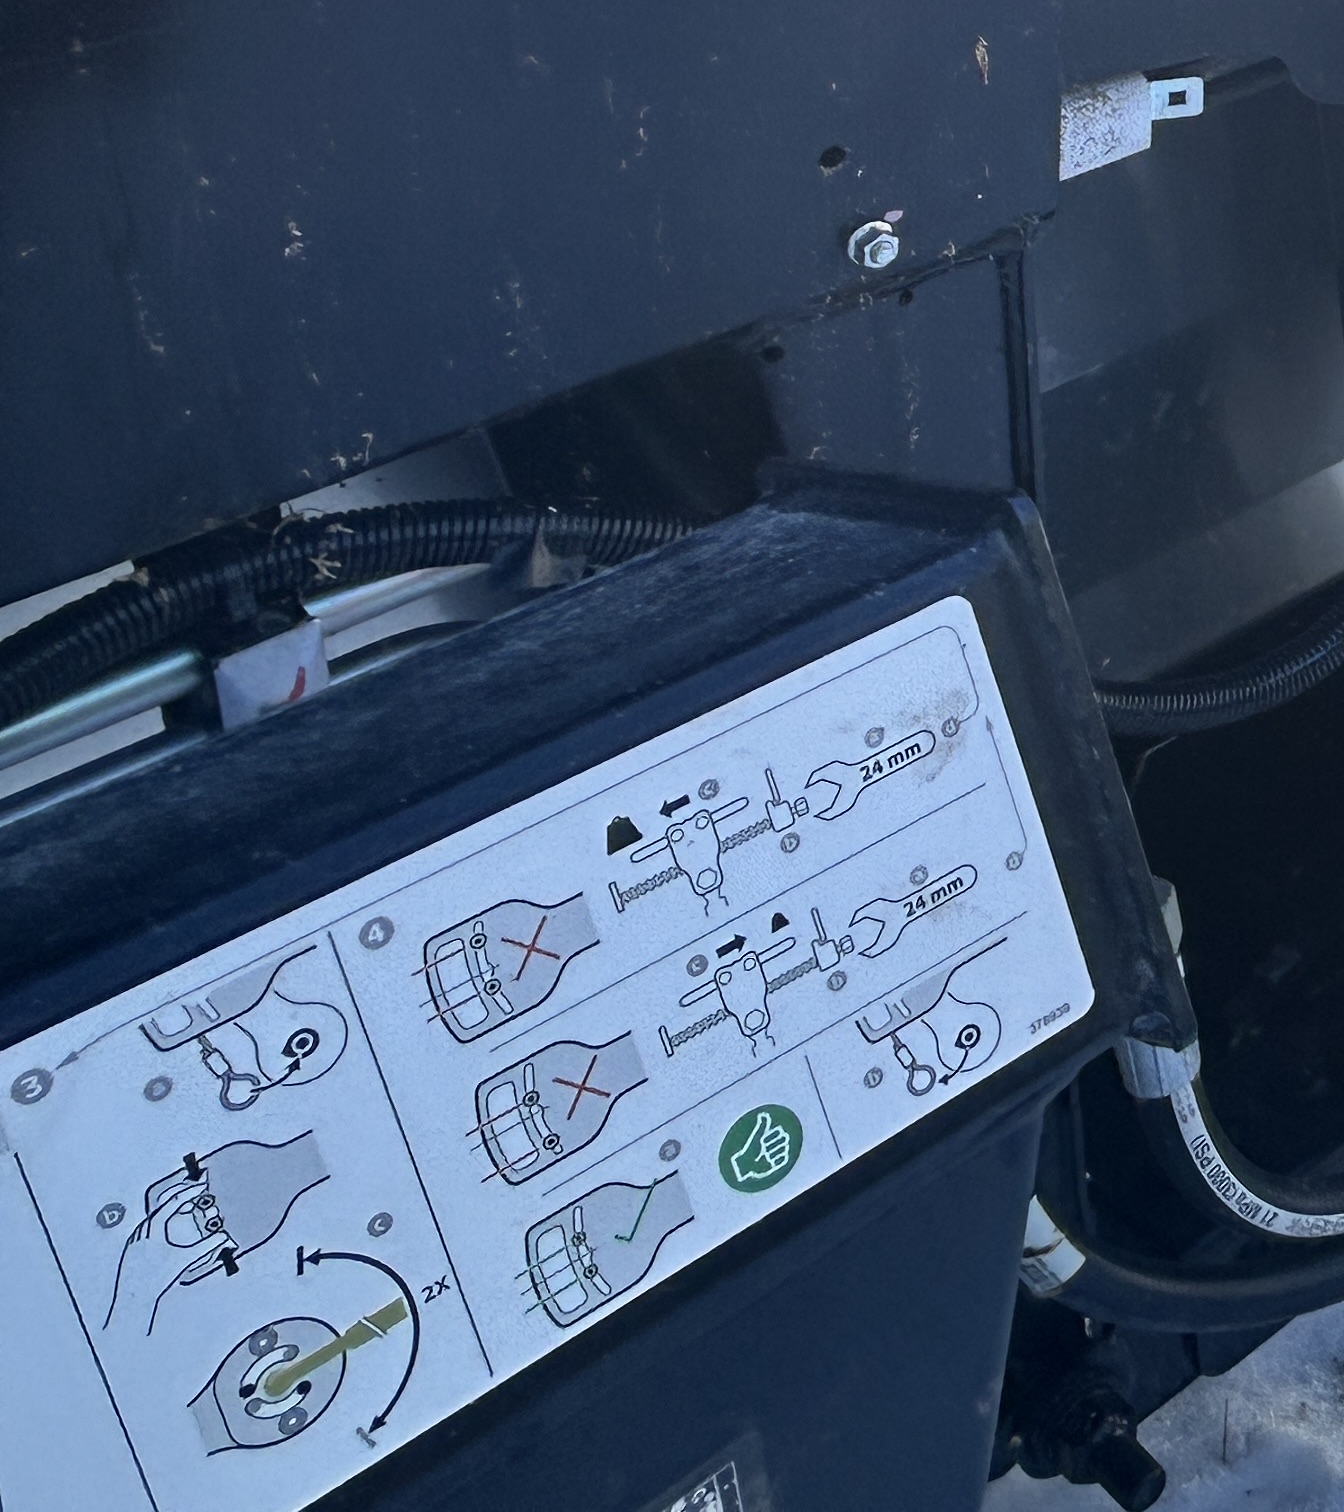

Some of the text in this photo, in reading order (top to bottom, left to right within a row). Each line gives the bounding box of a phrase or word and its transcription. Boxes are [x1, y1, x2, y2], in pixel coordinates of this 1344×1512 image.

[859, 742, 922, 783] 24 mm
[903, 876, 964, 919] 24 mm
